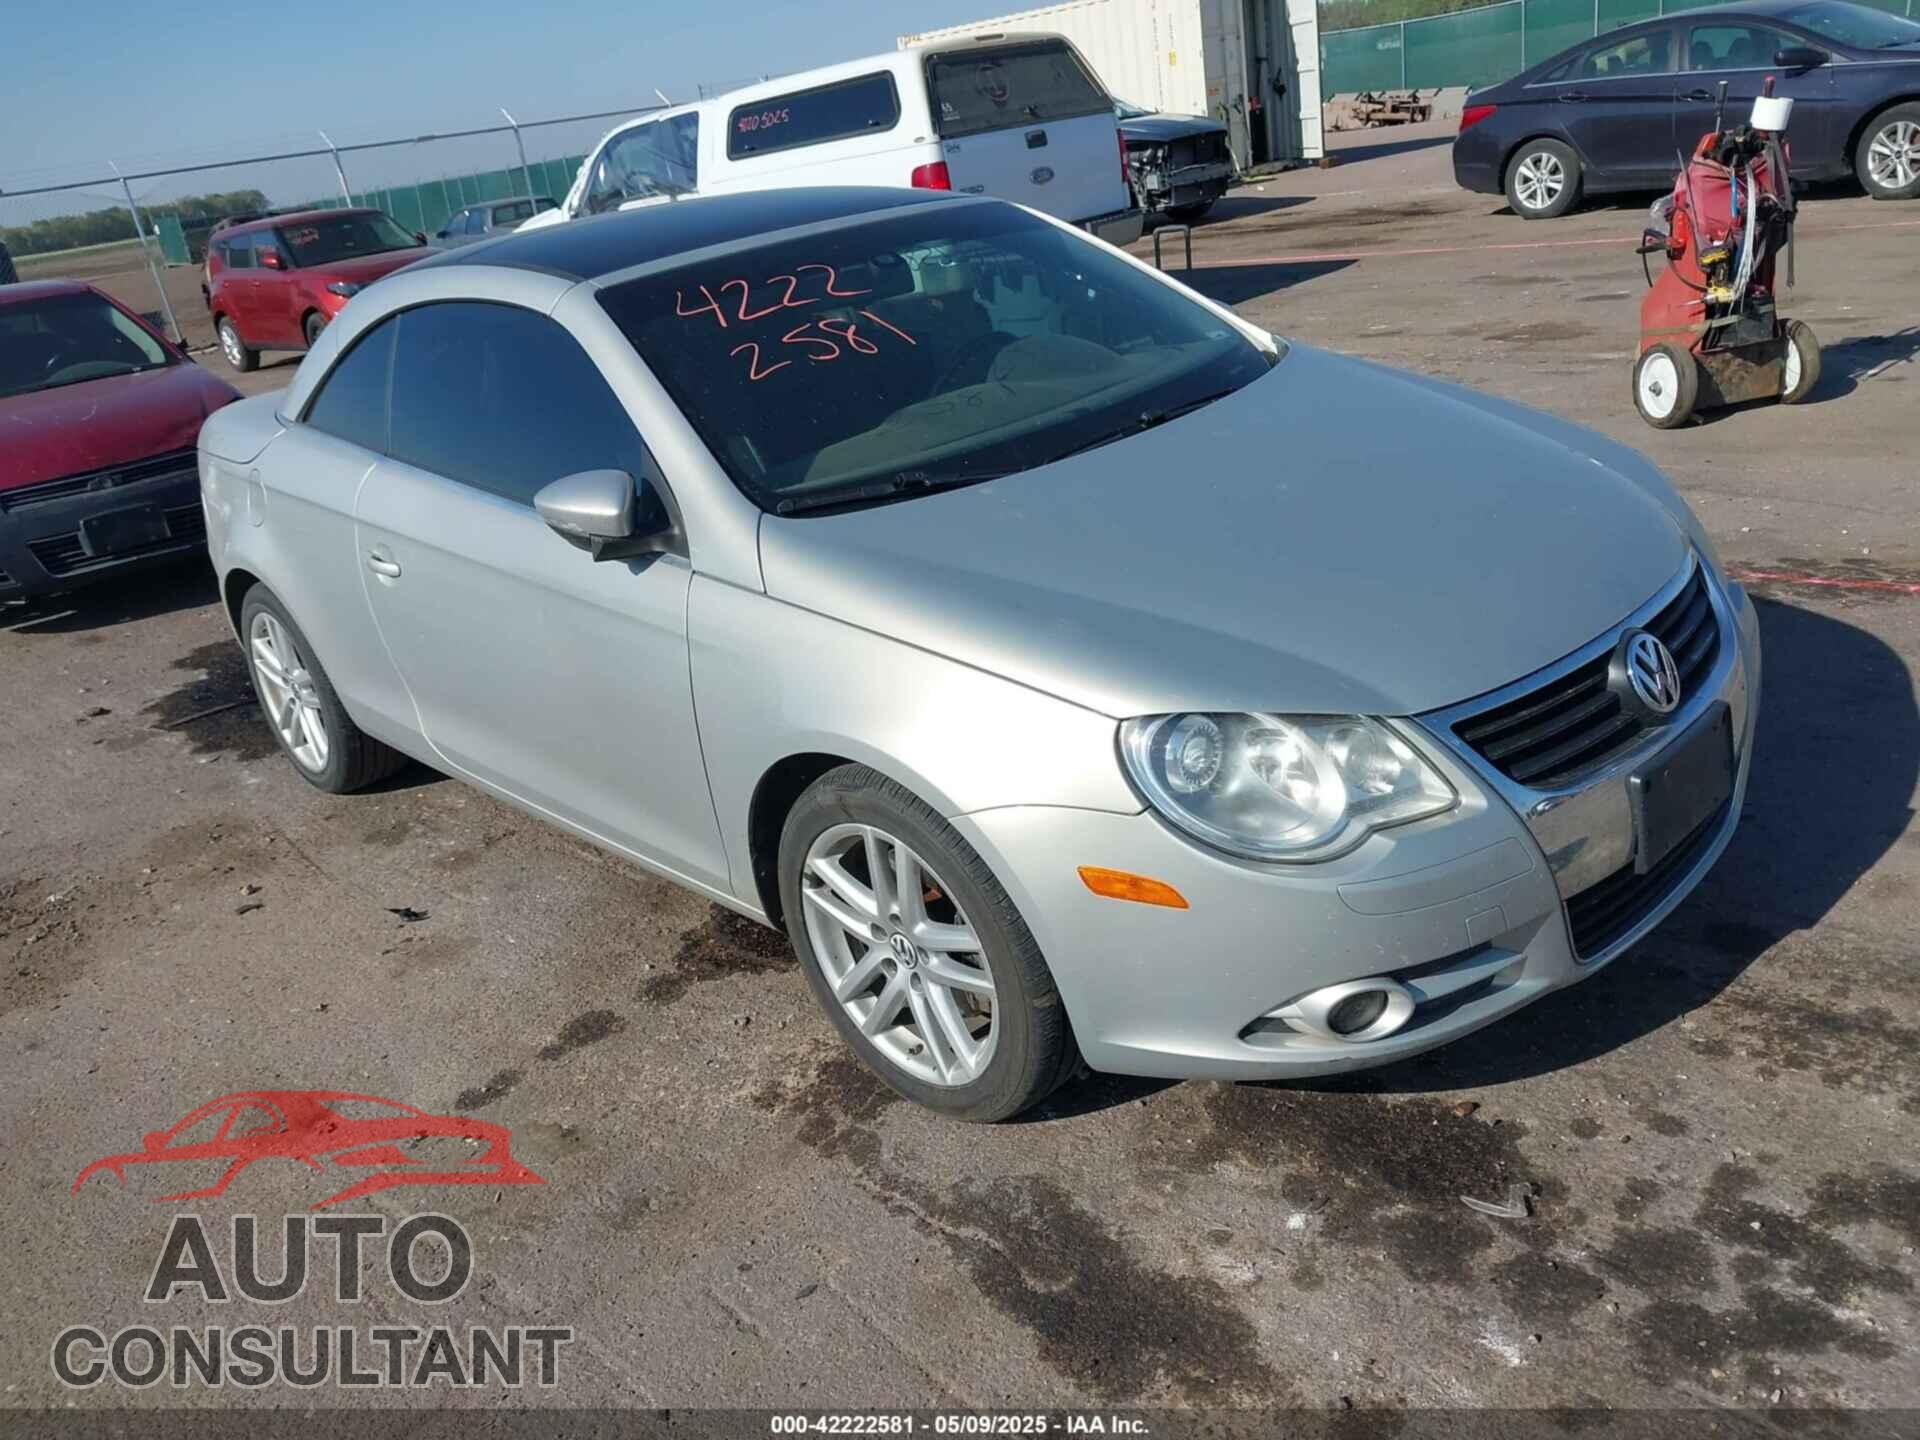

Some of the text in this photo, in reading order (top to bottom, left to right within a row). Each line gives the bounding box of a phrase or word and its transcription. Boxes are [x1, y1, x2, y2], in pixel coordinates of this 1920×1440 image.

[675, 263, 873, 328] 4222
[729, 311, 917, 381] 2581
[1627, 633, 1681, 713] VW
